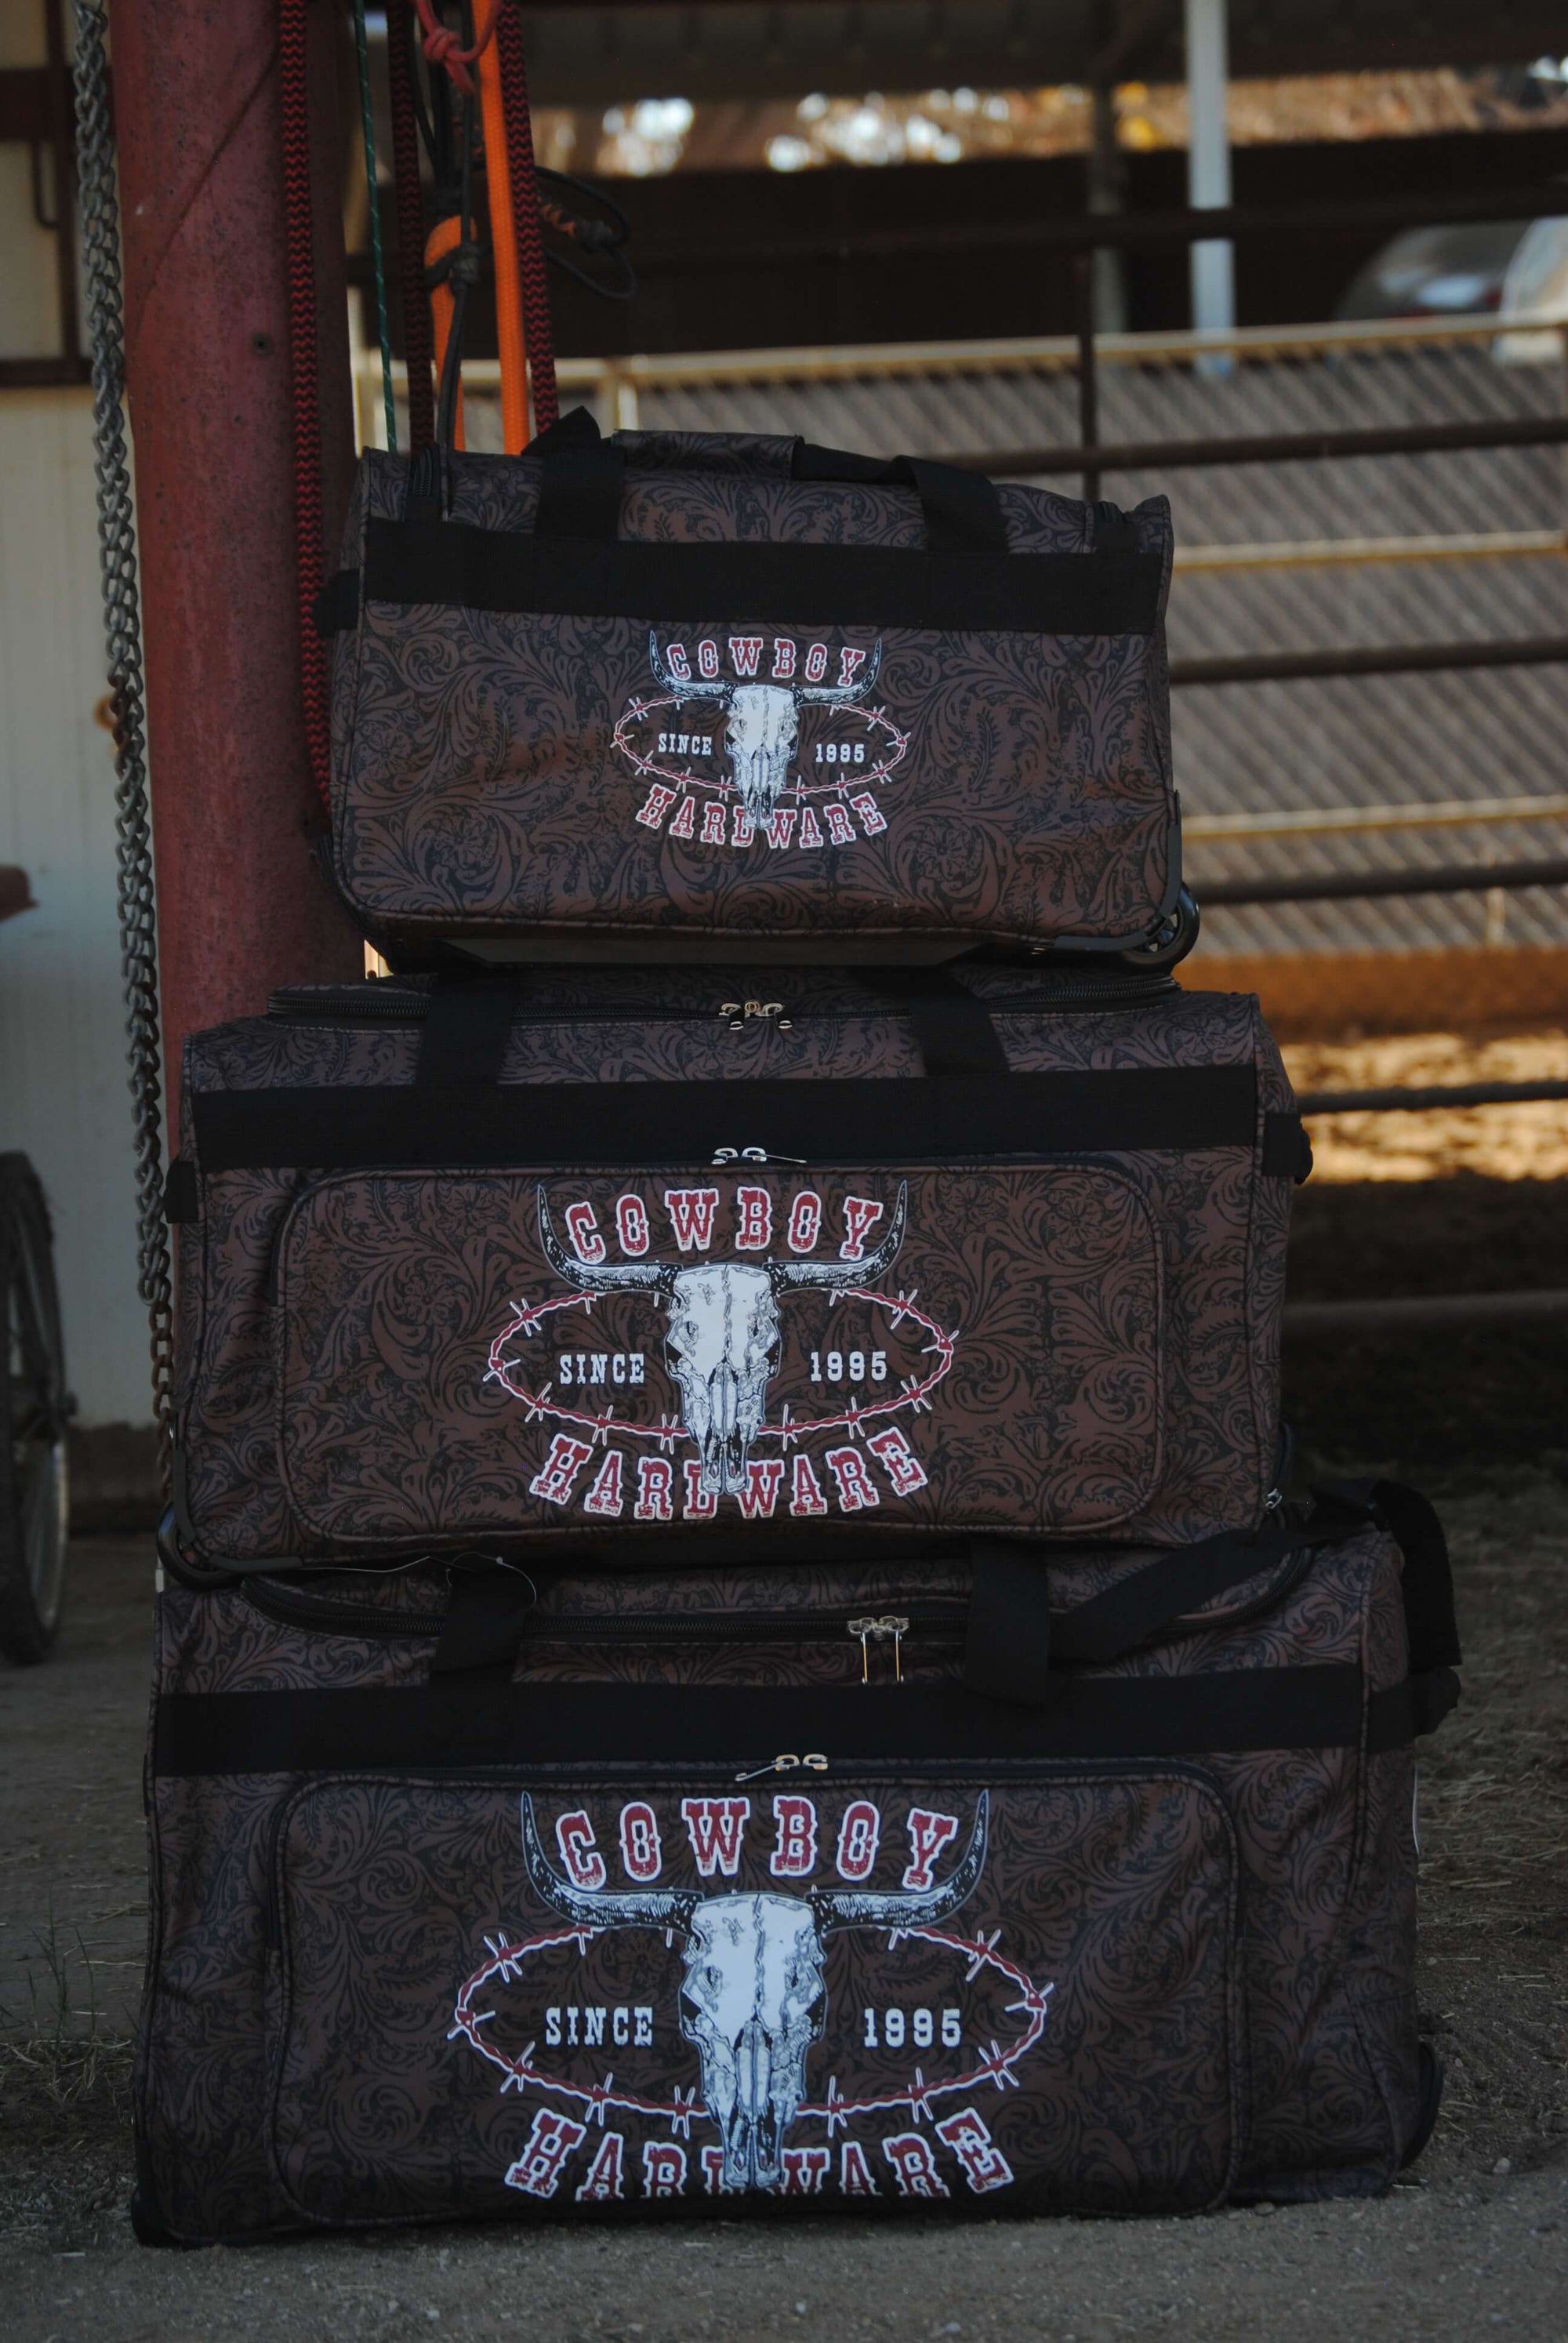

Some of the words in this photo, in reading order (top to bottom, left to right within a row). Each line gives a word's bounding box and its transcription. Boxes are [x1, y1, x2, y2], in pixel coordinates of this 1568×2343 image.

[666, 637, 866, 687] COWBOY
[658, 732, 713, 756] SINCE
[815, 743, 865, 763] 1995
[636, 783, 887, 848] HARDWARE
[564, 1186, 884, 1262] COWBOY
[559, 1353, 644, 1385] SINCE
[810, 1351, 887, 1382] 1995
[529, 1426, 928, 1520] HARDWARE
[555, 1795, 957, 1891] COWBOY
[545, 2006, 654, 2047] SINCE
[864, 2007, 962, 2048] 1995
